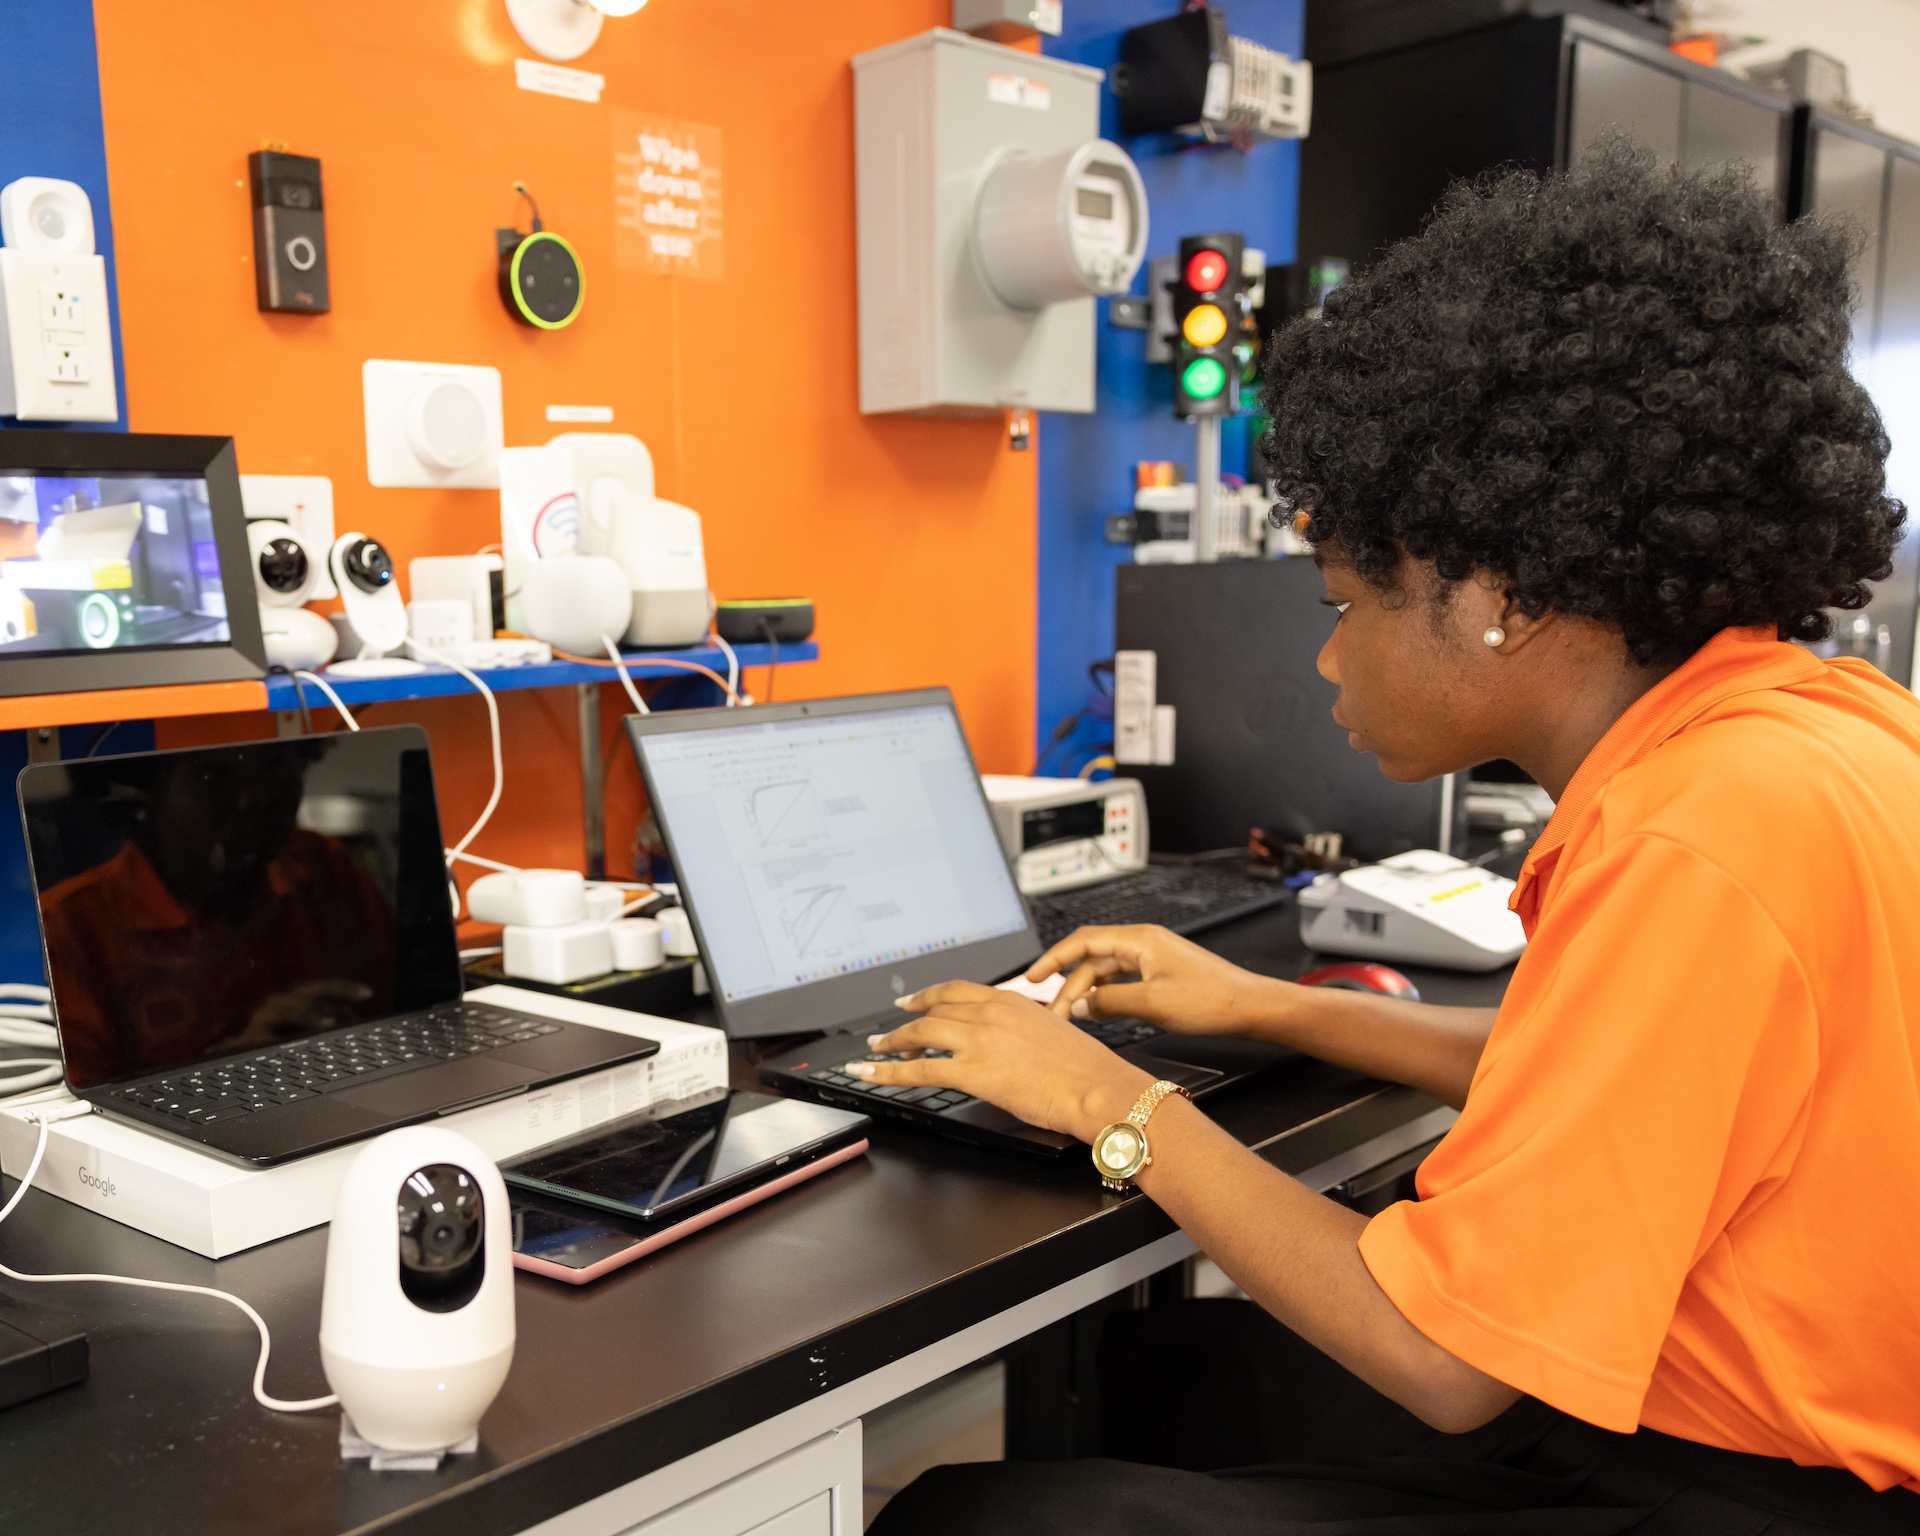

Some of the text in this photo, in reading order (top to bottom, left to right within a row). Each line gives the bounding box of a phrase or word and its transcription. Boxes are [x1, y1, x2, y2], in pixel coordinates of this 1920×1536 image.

[638, 135, 699, 173] Wipe
[638, 167, 702, 200] down
[643, 199, 698, 229] after
[650, 234, 692, 257] use
[78, 1165, 117, 1197] Google
